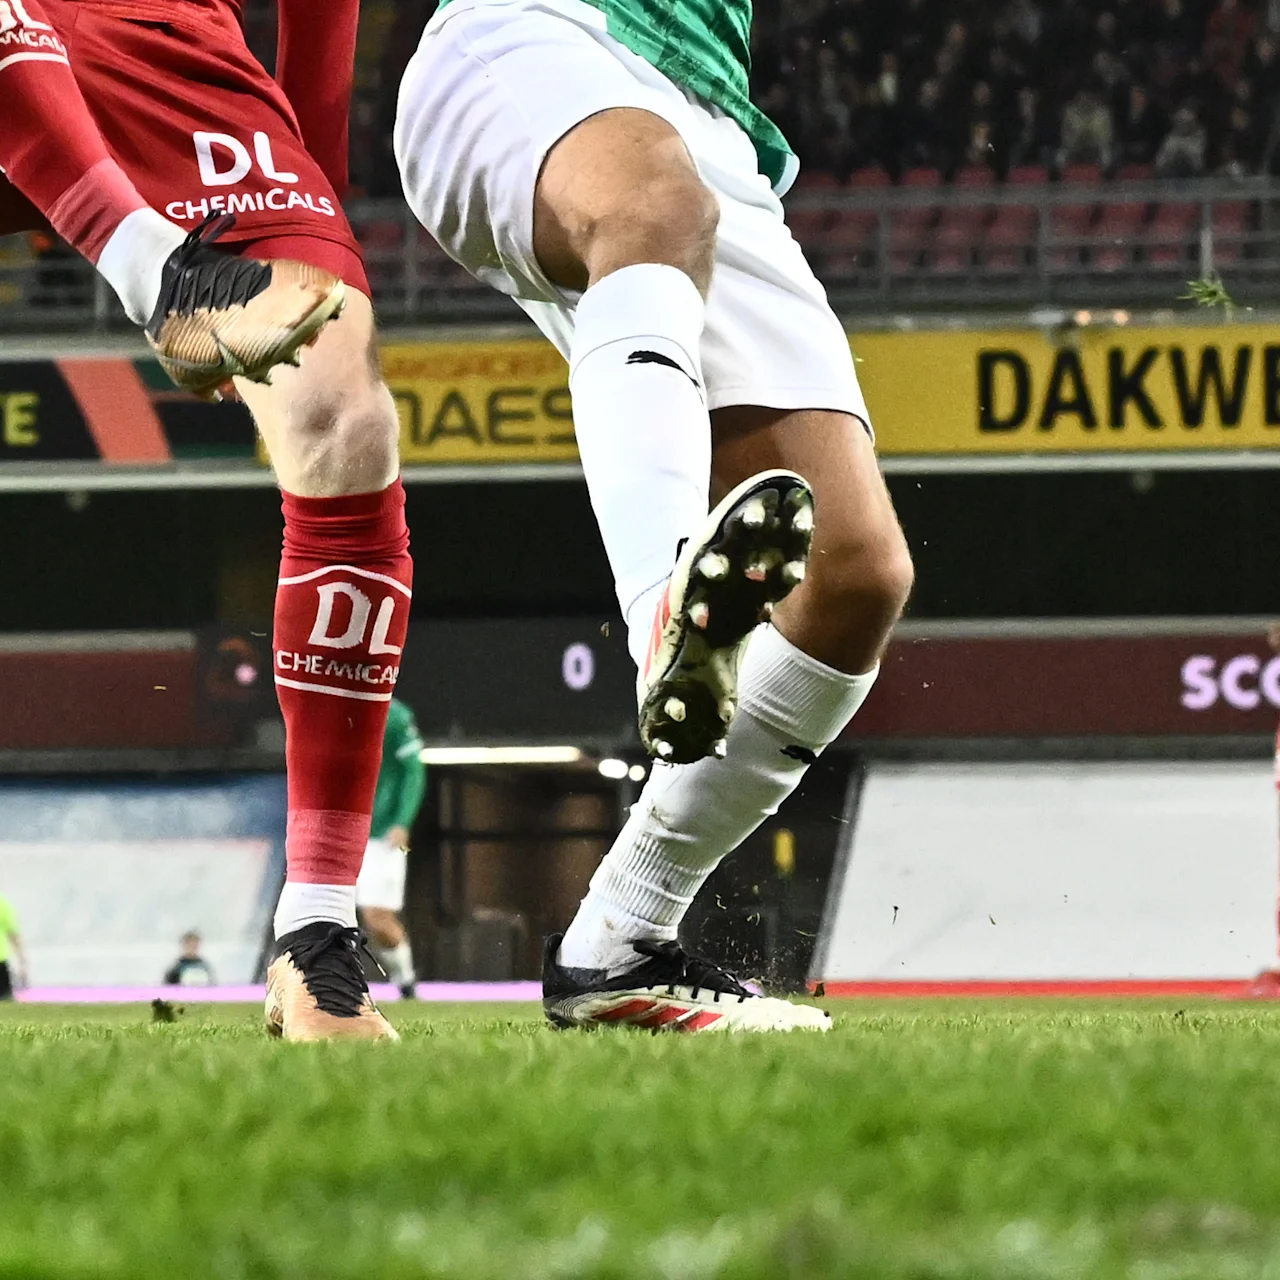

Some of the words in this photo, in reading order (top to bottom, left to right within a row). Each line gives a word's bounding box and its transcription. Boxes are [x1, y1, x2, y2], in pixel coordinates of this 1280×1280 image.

[192, 131, 299, 187] DL
[165, 188, 336, 219] CHEMICALS
[307, 581, 402, 655] DL
